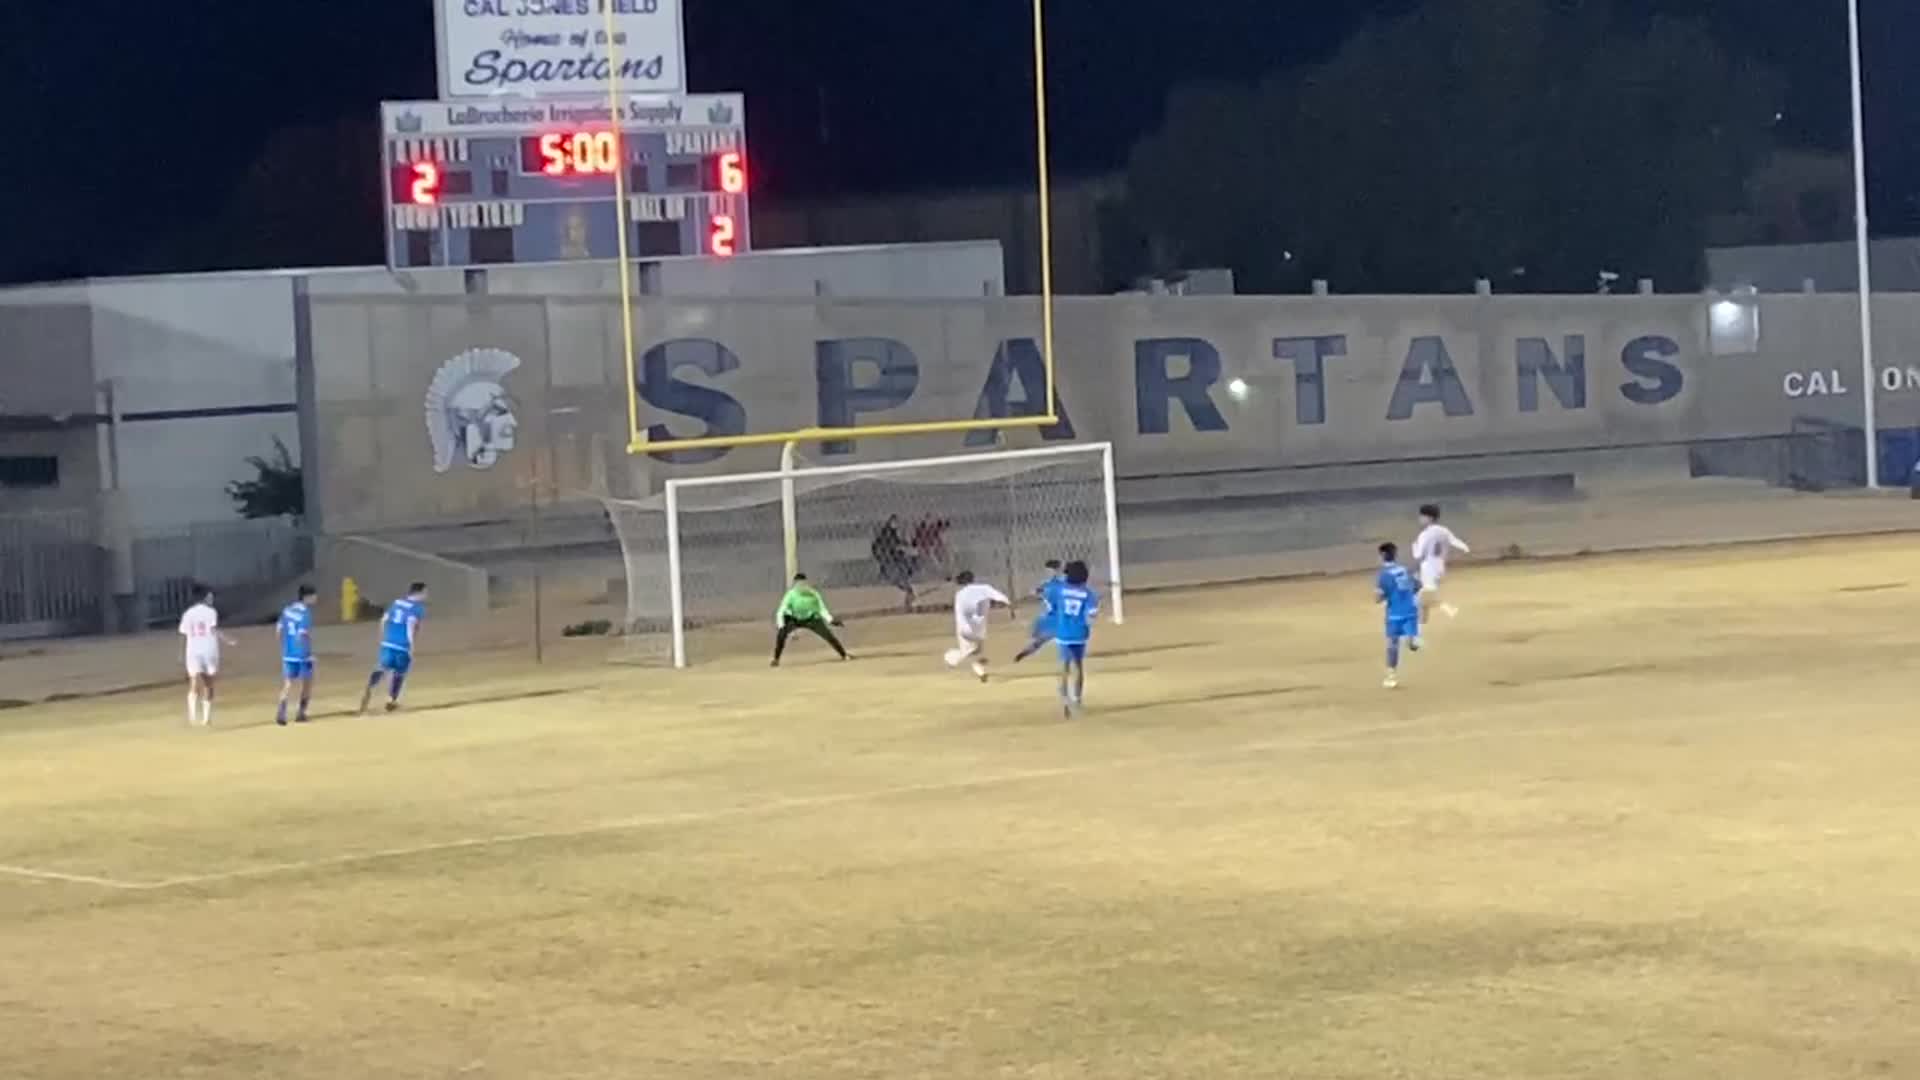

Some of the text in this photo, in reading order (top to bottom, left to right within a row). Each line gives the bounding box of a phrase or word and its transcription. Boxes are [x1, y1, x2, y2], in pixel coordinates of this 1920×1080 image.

[464, 0, 509, 17] CAL
[464, 49, 664, 87] Spartans
[539, 131, 618, 175] 5:00
[718, 152, 744, 194] 6
[411, 162, 438, 205] 2
[711, 215, 736, 257] 2
[636, 335, 1684, 464] SPARTANS
[1783, 370, 1847, 396] CAL
